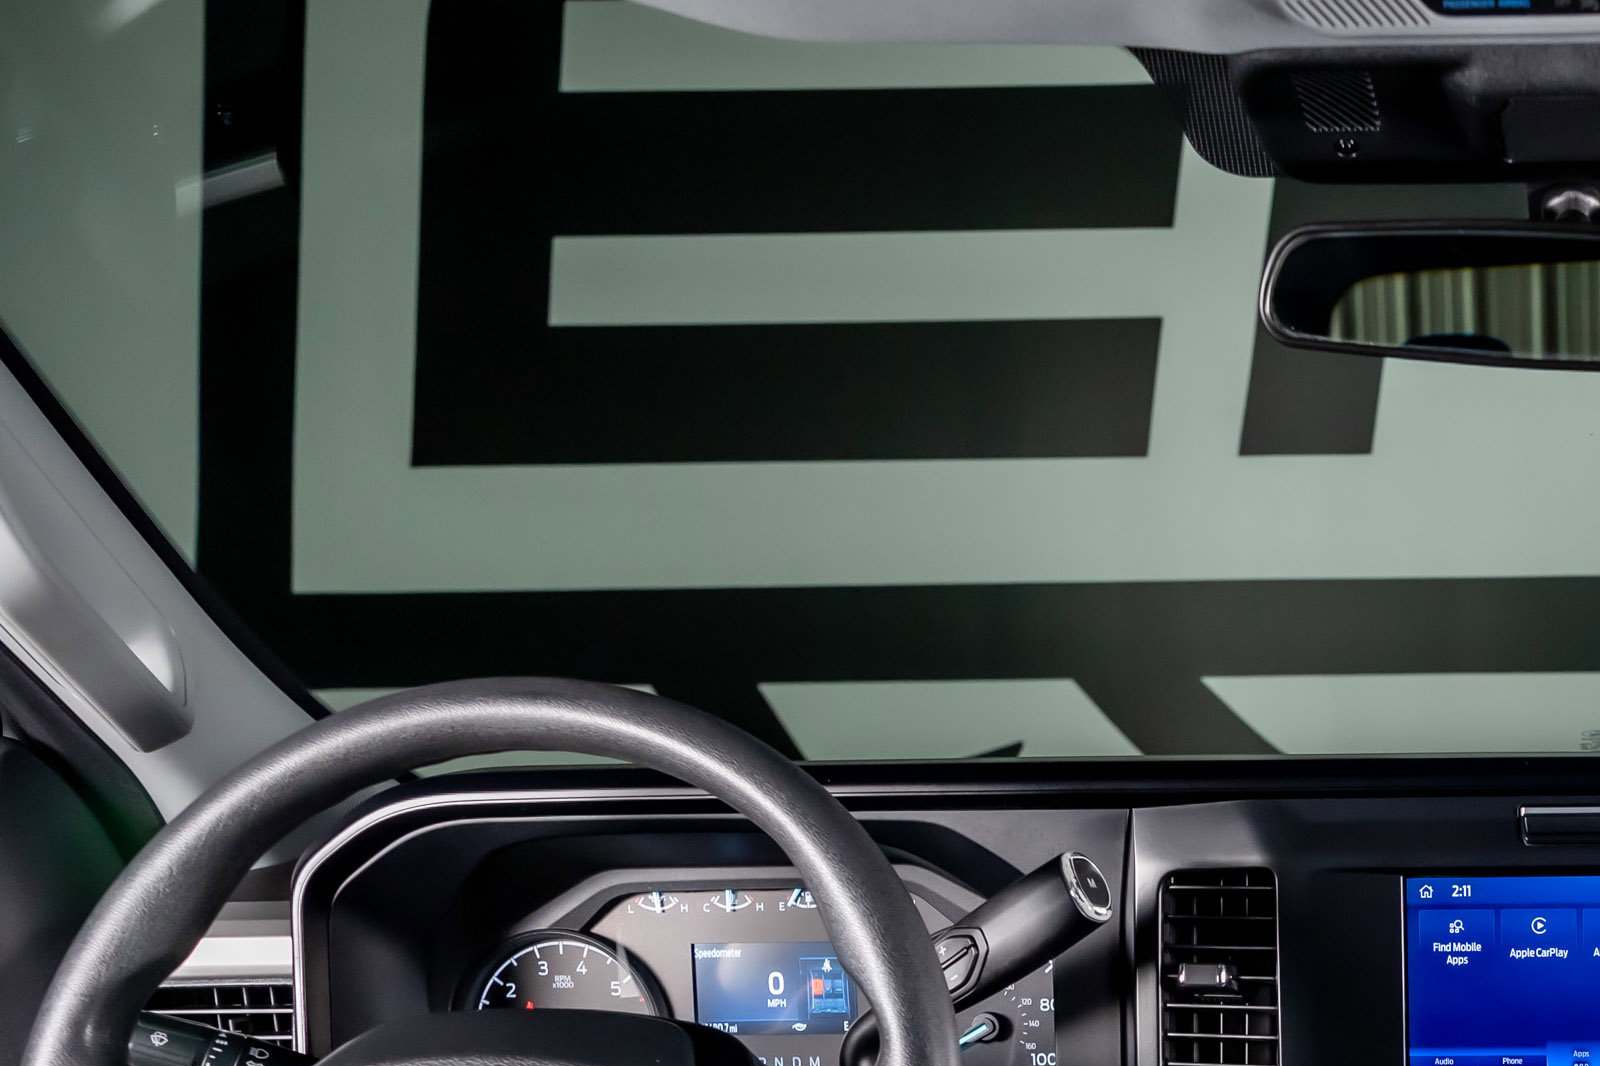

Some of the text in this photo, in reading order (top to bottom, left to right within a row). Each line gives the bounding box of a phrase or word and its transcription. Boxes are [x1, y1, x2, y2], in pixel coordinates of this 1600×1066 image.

[1451, 884, 1472, 897] 2:11
[627, 904, 635, 914] L
[680, 903, 689, 913] H
[702, 903, 711, 913] C
[755, 902, 764, 912] H
[779, 902, 786, 912] E
[1432, 942, 1482, 952] Find Mobile
[694, 947, 742, 959] Speedometer
[1509, 947, 1569, 959] Apple CarPlay
[1446, 955, 1469, 966] Apps
[537, 960, 549, 976] 3
[575, 960, 588, 975] 4
[552, 981, 575, 989] x1000
[610, 981, 621, 996] 5
[767, 971, 785, 996] 0
[505, 982, 517, 998] 2
[767, 998, 787, 1008] MPH
[1021, 998, 1033, 1006] 120
[729, 1023, 738, 1033] mi
[1573, 1050, 1590, 1058] Apps
[1434, 1057, 1454, 1065] Audio
[1502, 1057, 1523, 1065] Phone
